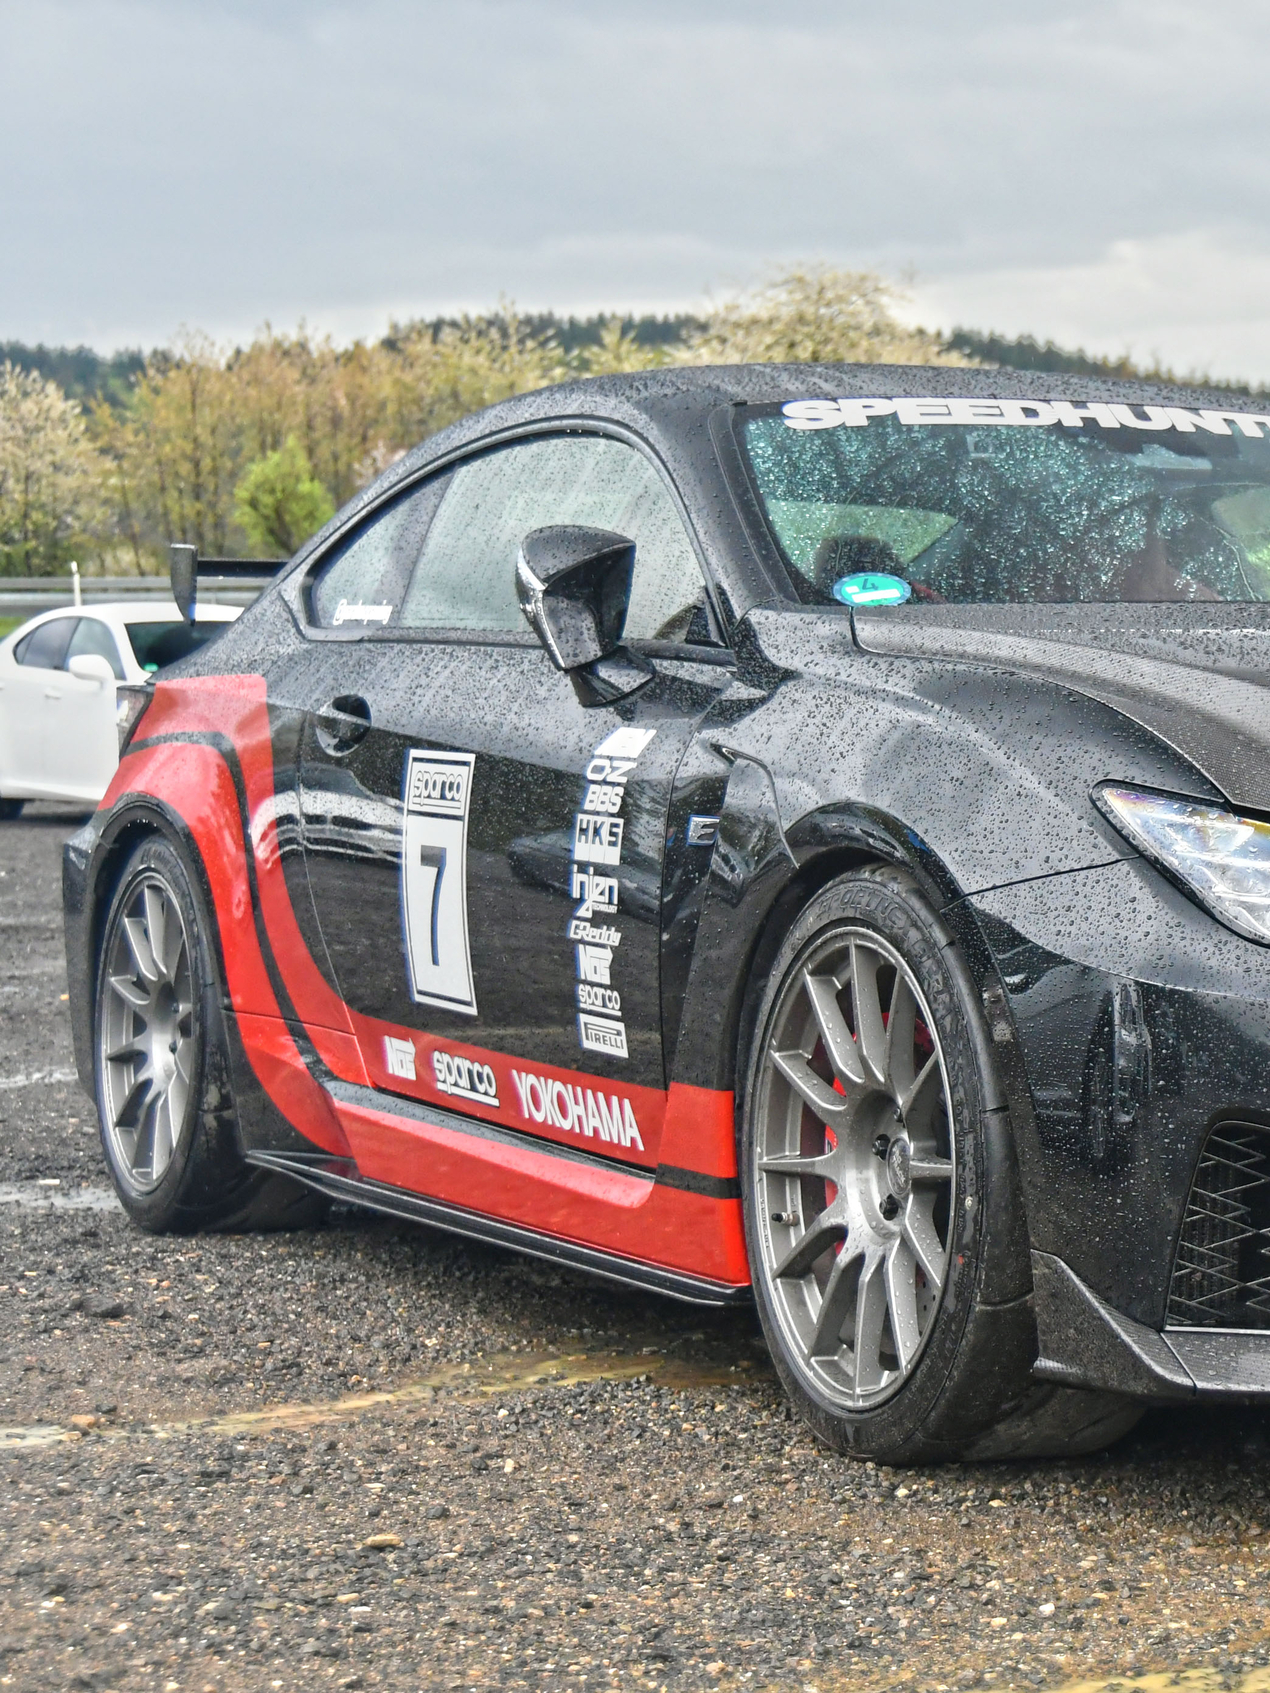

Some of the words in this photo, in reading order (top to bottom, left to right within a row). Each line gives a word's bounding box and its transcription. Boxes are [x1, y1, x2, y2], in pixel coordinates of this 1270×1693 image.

[861, 577, 880, 591] 4
[586, 758, 637, 784] OZ
[412, 770, 464, 807] sparco
[584, 784, 625, 814] BBS
[577, 817, 621, 848] HKS
[420, 844, 447, 967] 7
[569, 919, 622, 947] GReddy
[578, 983, 621, 1012] sparco
[583, 1021, 625, 1050] PIRELLI
[433, 1050, 498, 1097] sparco
[512, 1069, 646, 1152] YOKOHAMA
